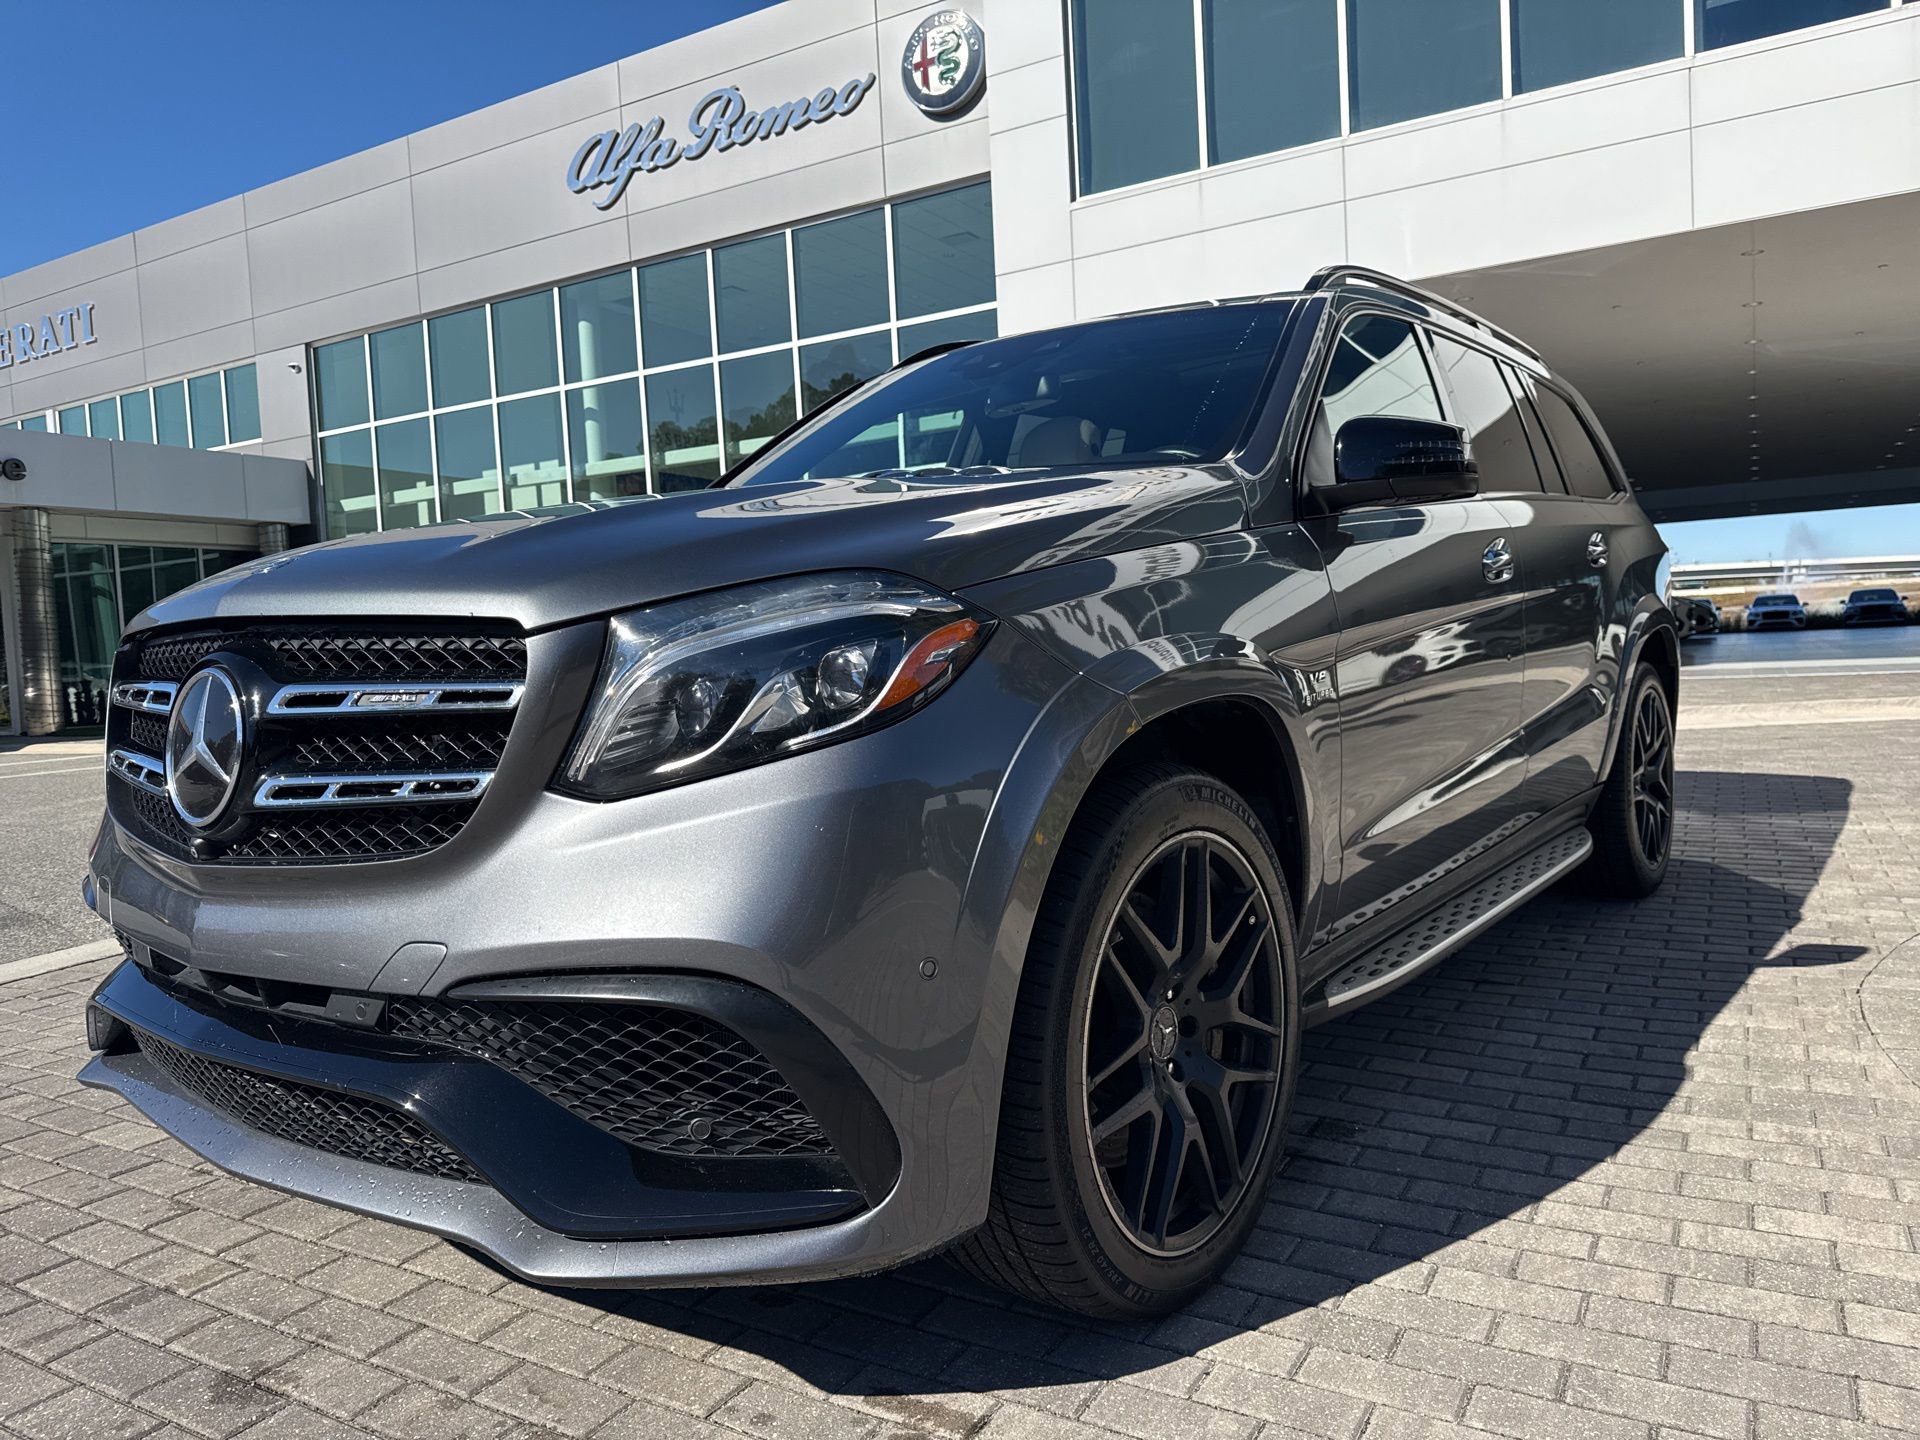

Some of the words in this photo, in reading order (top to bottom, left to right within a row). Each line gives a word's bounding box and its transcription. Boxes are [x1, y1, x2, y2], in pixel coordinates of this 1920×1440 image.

[566, 115, 682, 211] Alfa
[683, 72, 876, 161] Romeo
[0, 302, 96, 369] ERATI
[1201, 786, 1257, 829] MICHELIN
